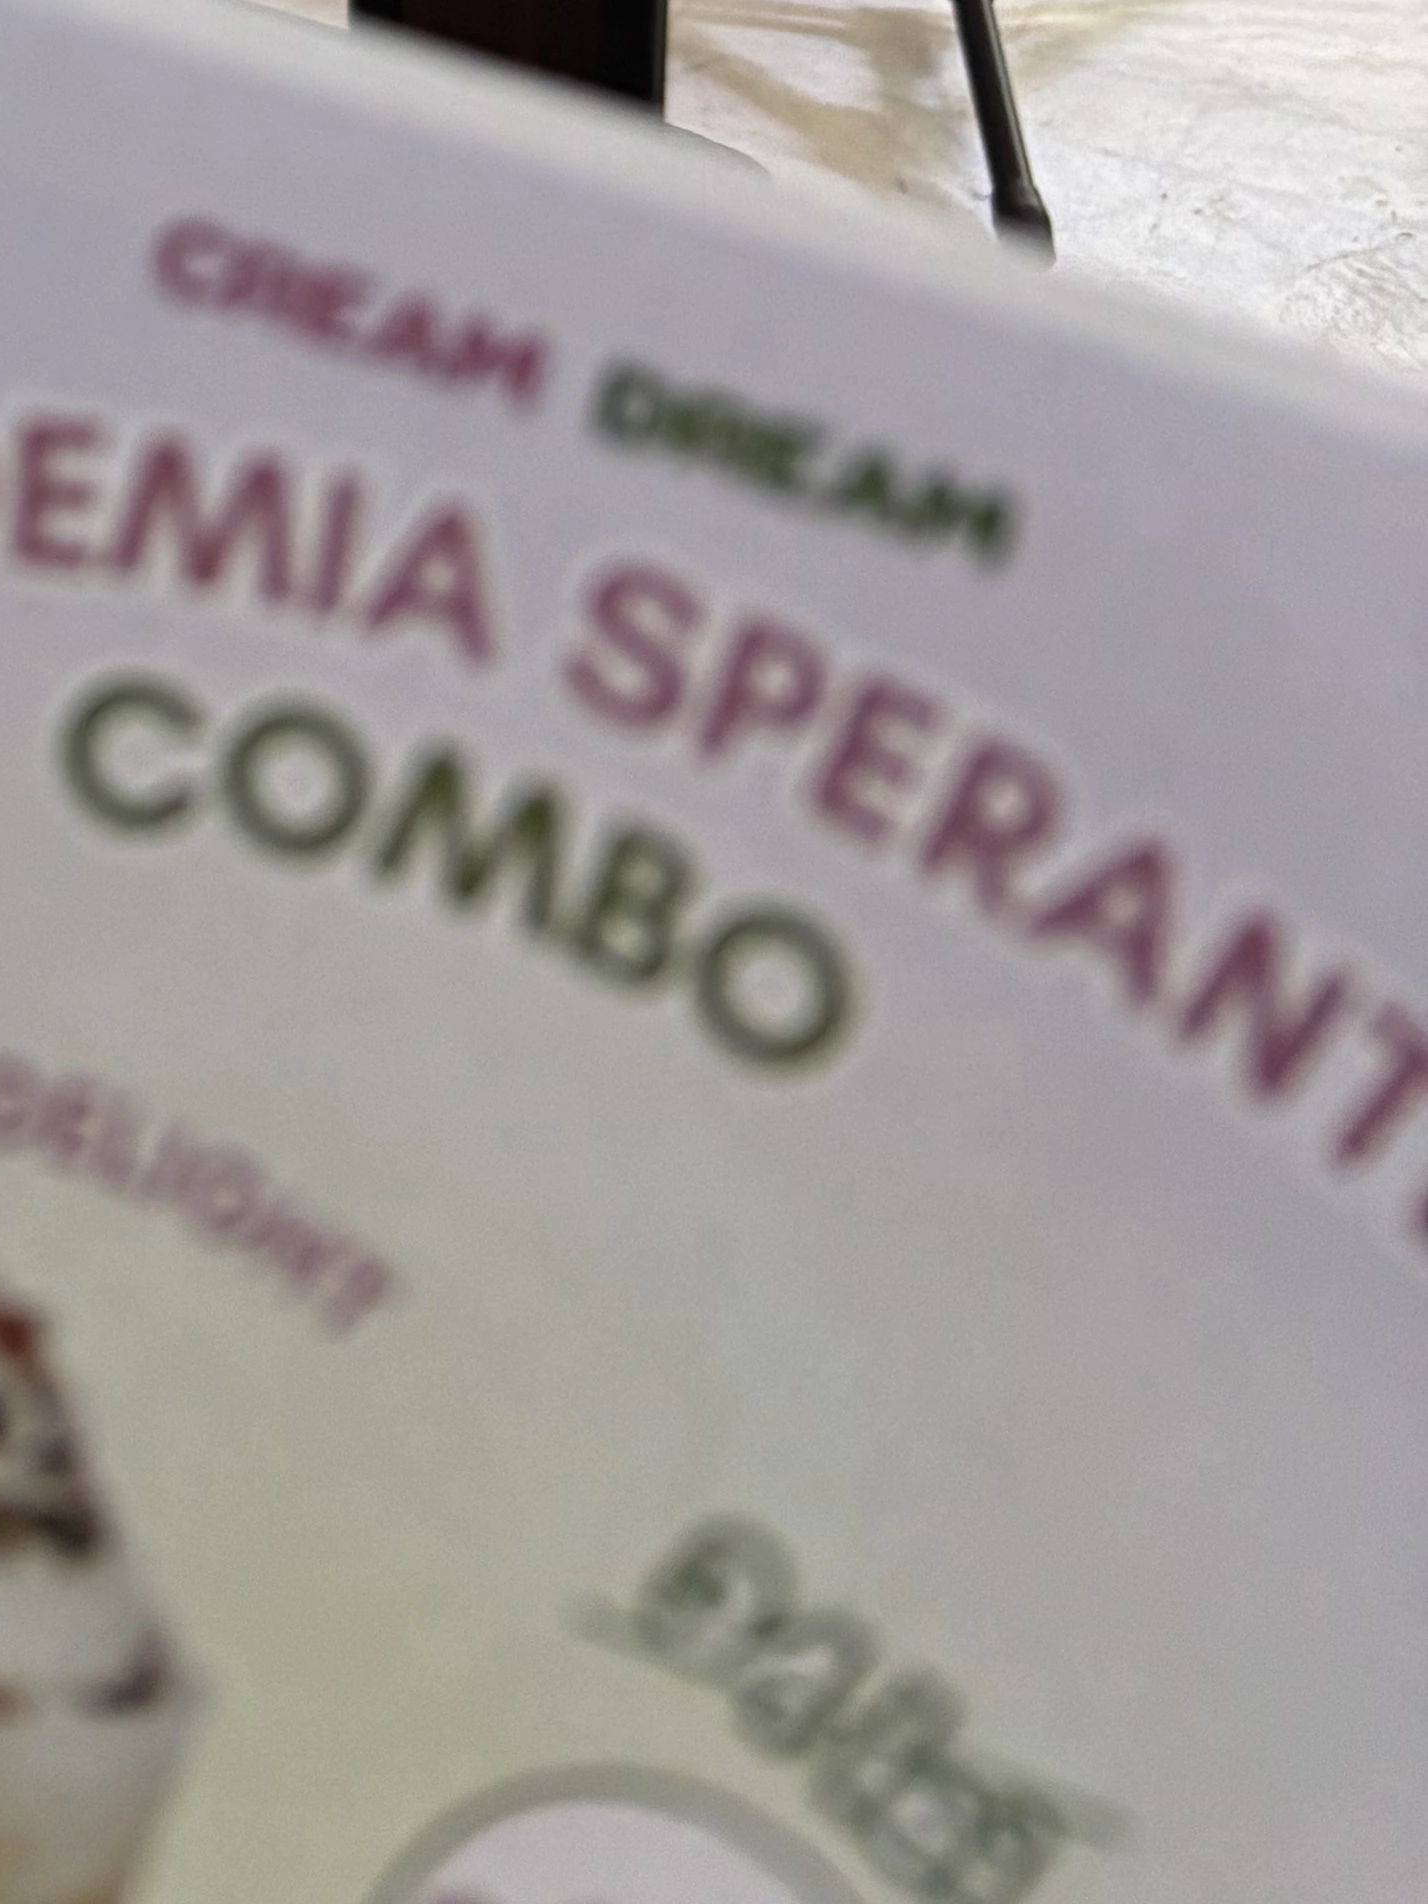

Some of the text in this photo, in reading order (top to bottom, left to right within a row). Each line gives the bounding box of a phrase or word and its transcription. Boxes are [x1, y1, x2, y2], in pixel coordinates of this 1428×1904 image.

[152, 217, 1024, 572] CREAM DREAM
[56, 674, 858, 1078] COMBO
[549, 554, 1428, 1247] SPERANT
